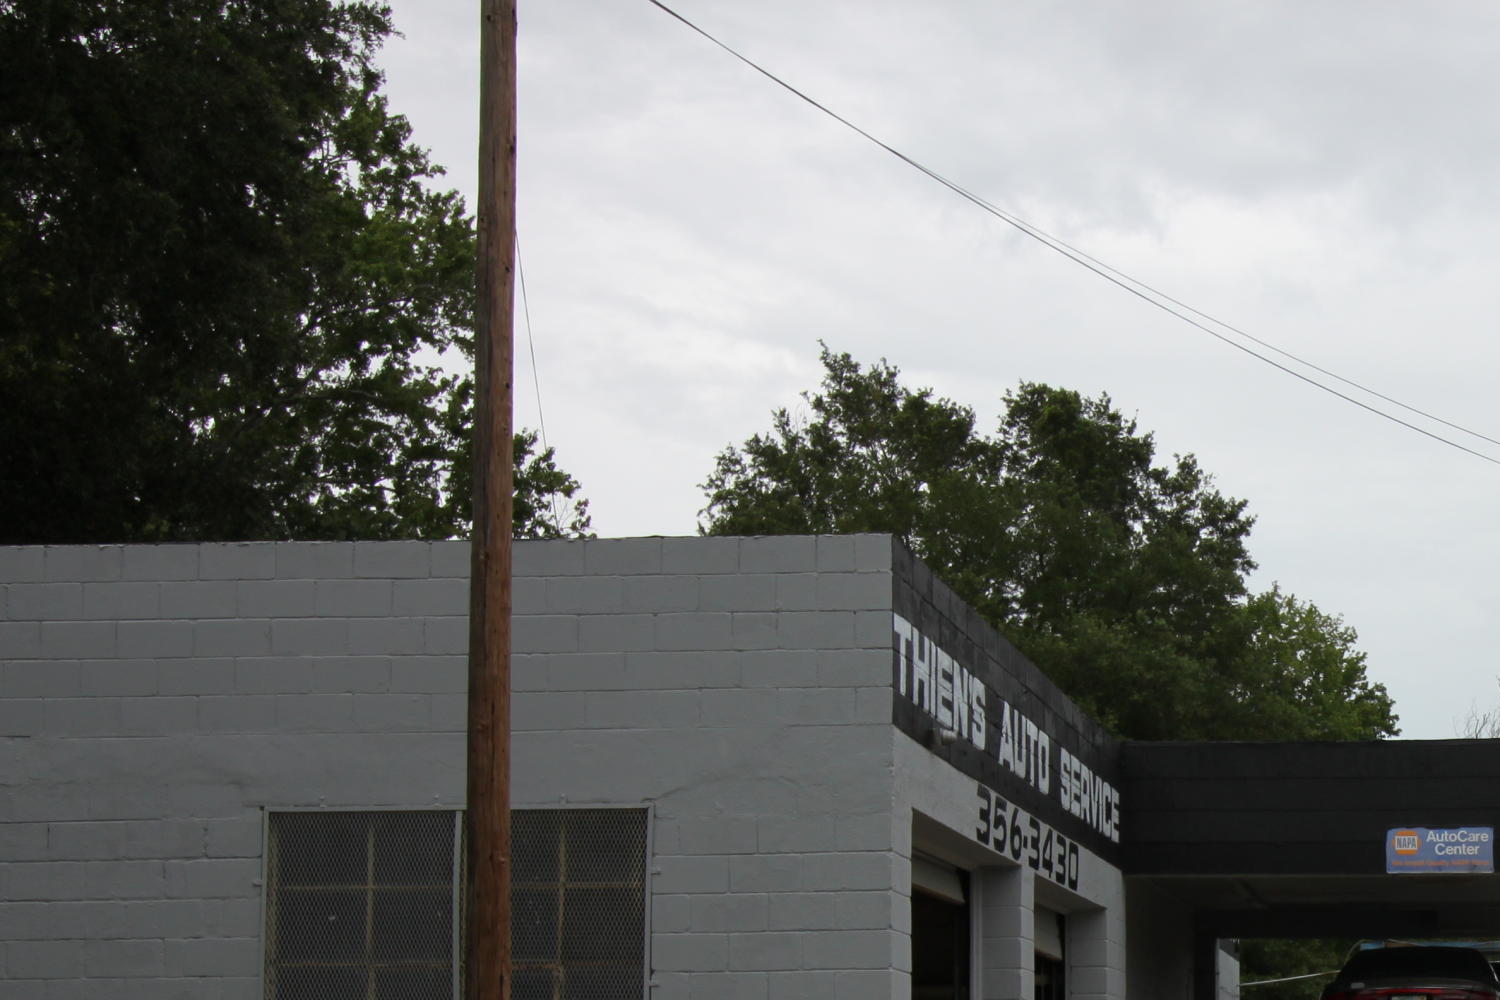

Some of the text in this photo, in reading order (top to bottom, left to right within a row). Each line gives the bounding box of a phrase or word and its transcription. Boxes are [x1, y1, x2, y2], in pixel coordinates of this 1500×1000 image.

[894, 612, 1120, 844] THIEN'S AUTO SERVICE
[975, 783, 1080, 892] 356-3430
[1426, 830, 1489, 843] AutoCare
[1396, 837, 1417, 850] NAPA
[1434, 843, 1480, 856] Center
